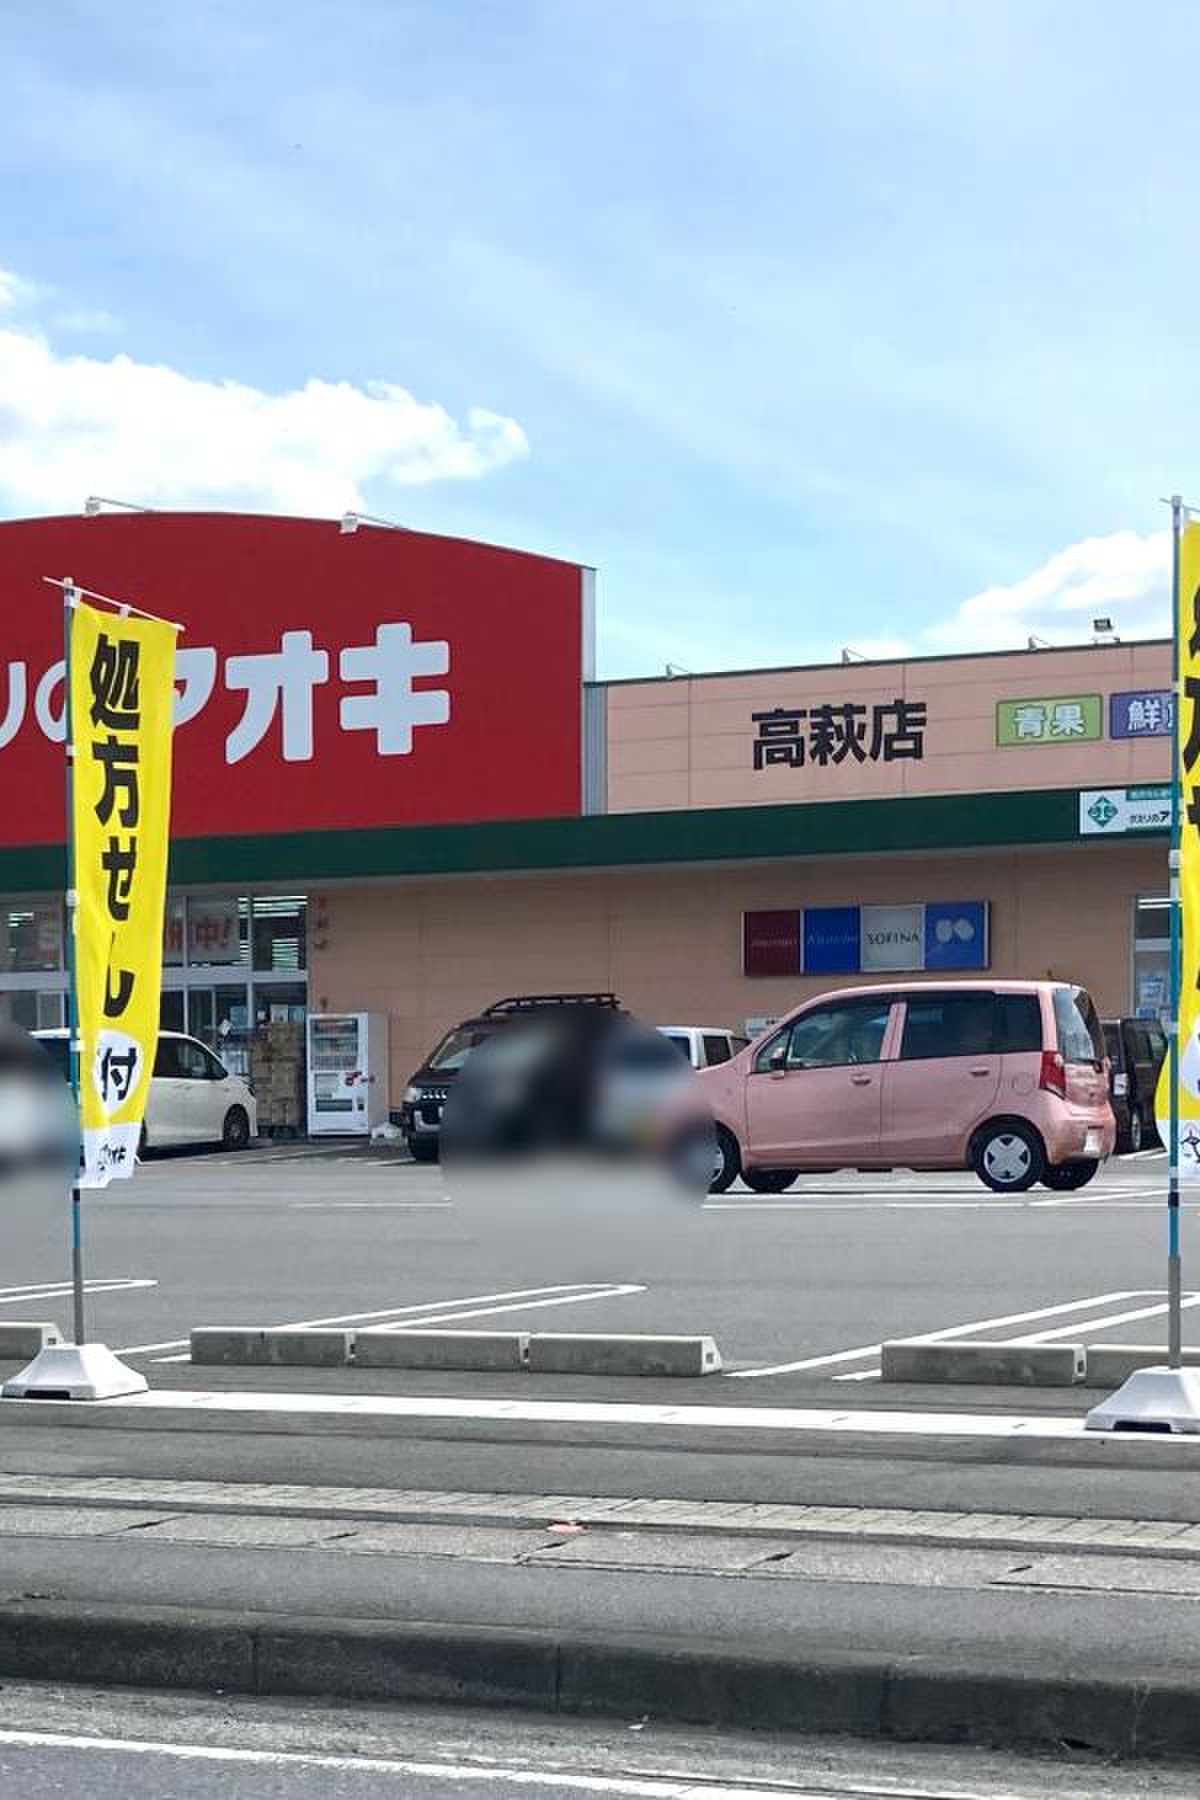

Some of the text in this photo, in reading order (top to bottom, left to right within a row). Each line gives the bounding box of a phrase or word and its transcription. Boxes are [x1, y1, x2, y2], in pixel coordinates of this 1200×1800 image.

[1013, 704, 1086, 738] 青果
[1126, 700, 1174, 734] 鮮
[751, 699, 928, 771] 高萩店
